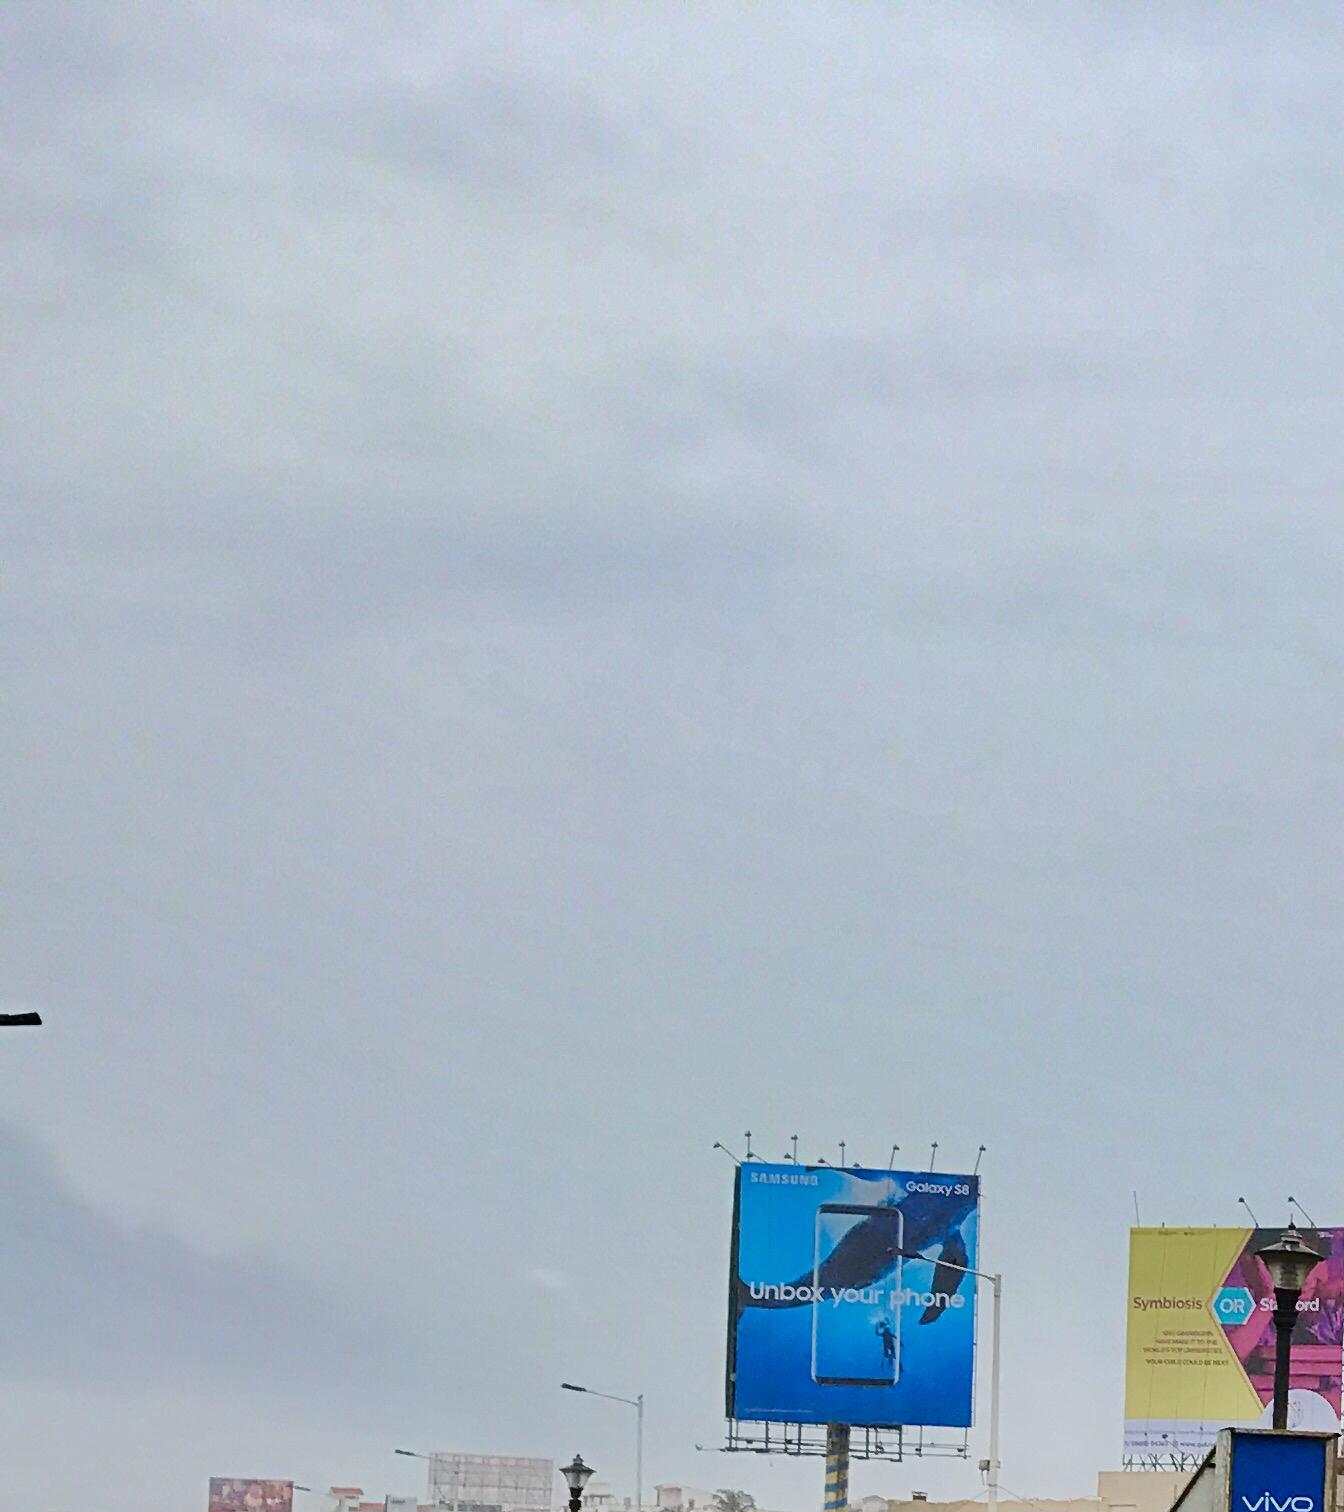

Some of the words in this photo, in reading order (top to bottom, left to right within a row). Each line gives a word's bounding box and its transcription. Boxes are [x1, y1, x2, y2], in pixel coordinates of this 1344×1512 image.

[750, 1172, 818, 1186] SAMSUNG
[905, 1180, 952, 1197] Galaxy
[954, 1183, 970, 1196] S8
[749, 1281, 824, 1303] Unbox
[830, 1287, 884, 1308] your
[890, 1291, 965, 1310] phone
[1133, 1297, 1203, 1312] Symbiosis
[1219, 1298, 1245, 1314] OR
[1260, 1297, 1320, 1312] Staord
[1241, 1491, 1314, 1512] vivo
